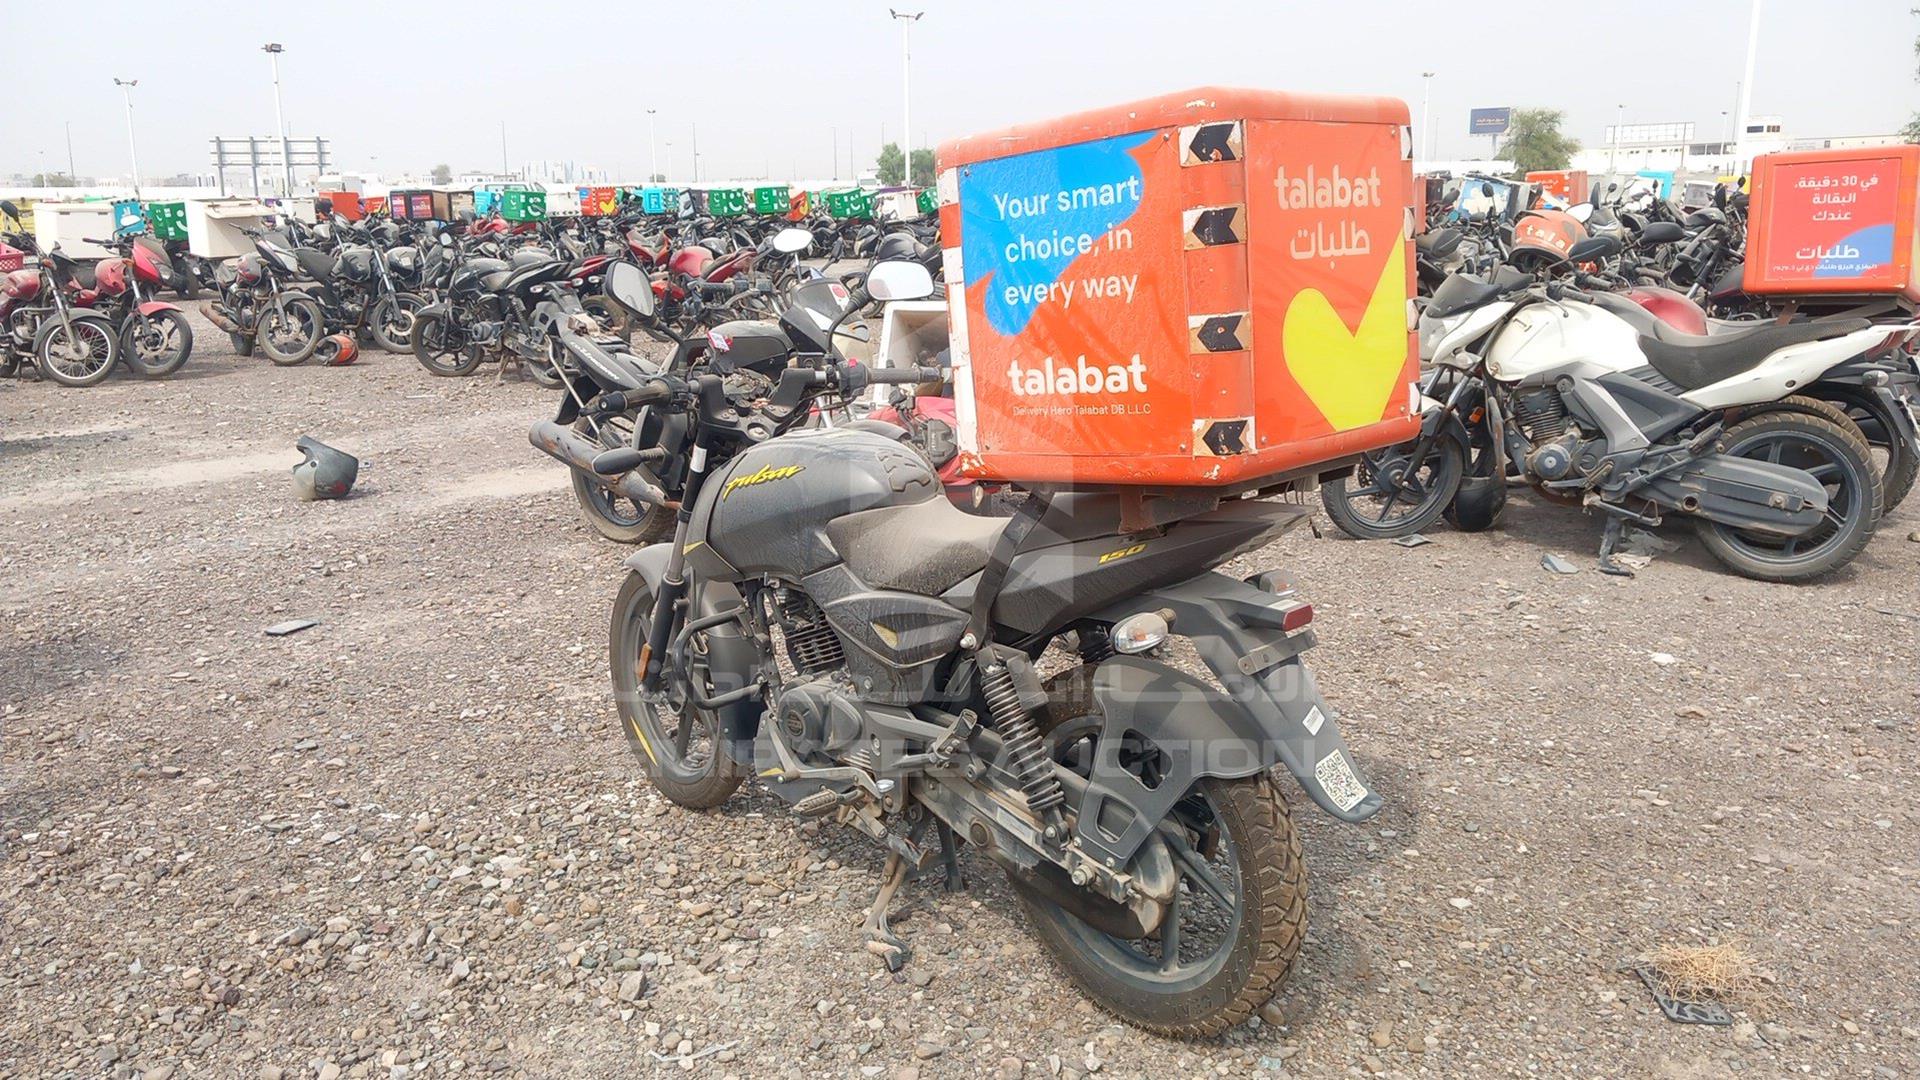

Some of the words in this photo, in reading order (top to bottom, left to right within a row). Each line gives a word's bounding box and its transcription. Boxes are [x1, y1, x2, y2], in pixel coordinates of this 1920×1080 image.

[994, 192, 1050, 221] Your
[1057, 175, 1140, 212] smart
[1273, 163, 1381, 210] talabat
[1842, 175, 1858, 186] 30
[1860, 174, 1879, 191] في
[1812, 192, 1857, 206] البقالة
[1812, 209, 1852, 221] عندك
[1005, 229, 1099, 263] choice,
[1107, 222, 1133, 251] in
[1290, 219, 1371, 270] طلبات
[1795, 244, 1860, 263] طلبات
[1004, 279, 1075, 309] every
[1082, 274, 1138, 304] way
[1006, 353, 1148, 396] talabat
[1013, 405, 1048, 417] Delivery
[1050, 405, 1072, 416] Hero
[1074, 404, 1108, 416] Talabat
[1110, 403, 1125, 415] DB
[723, 464, 806, 502] pulsar
